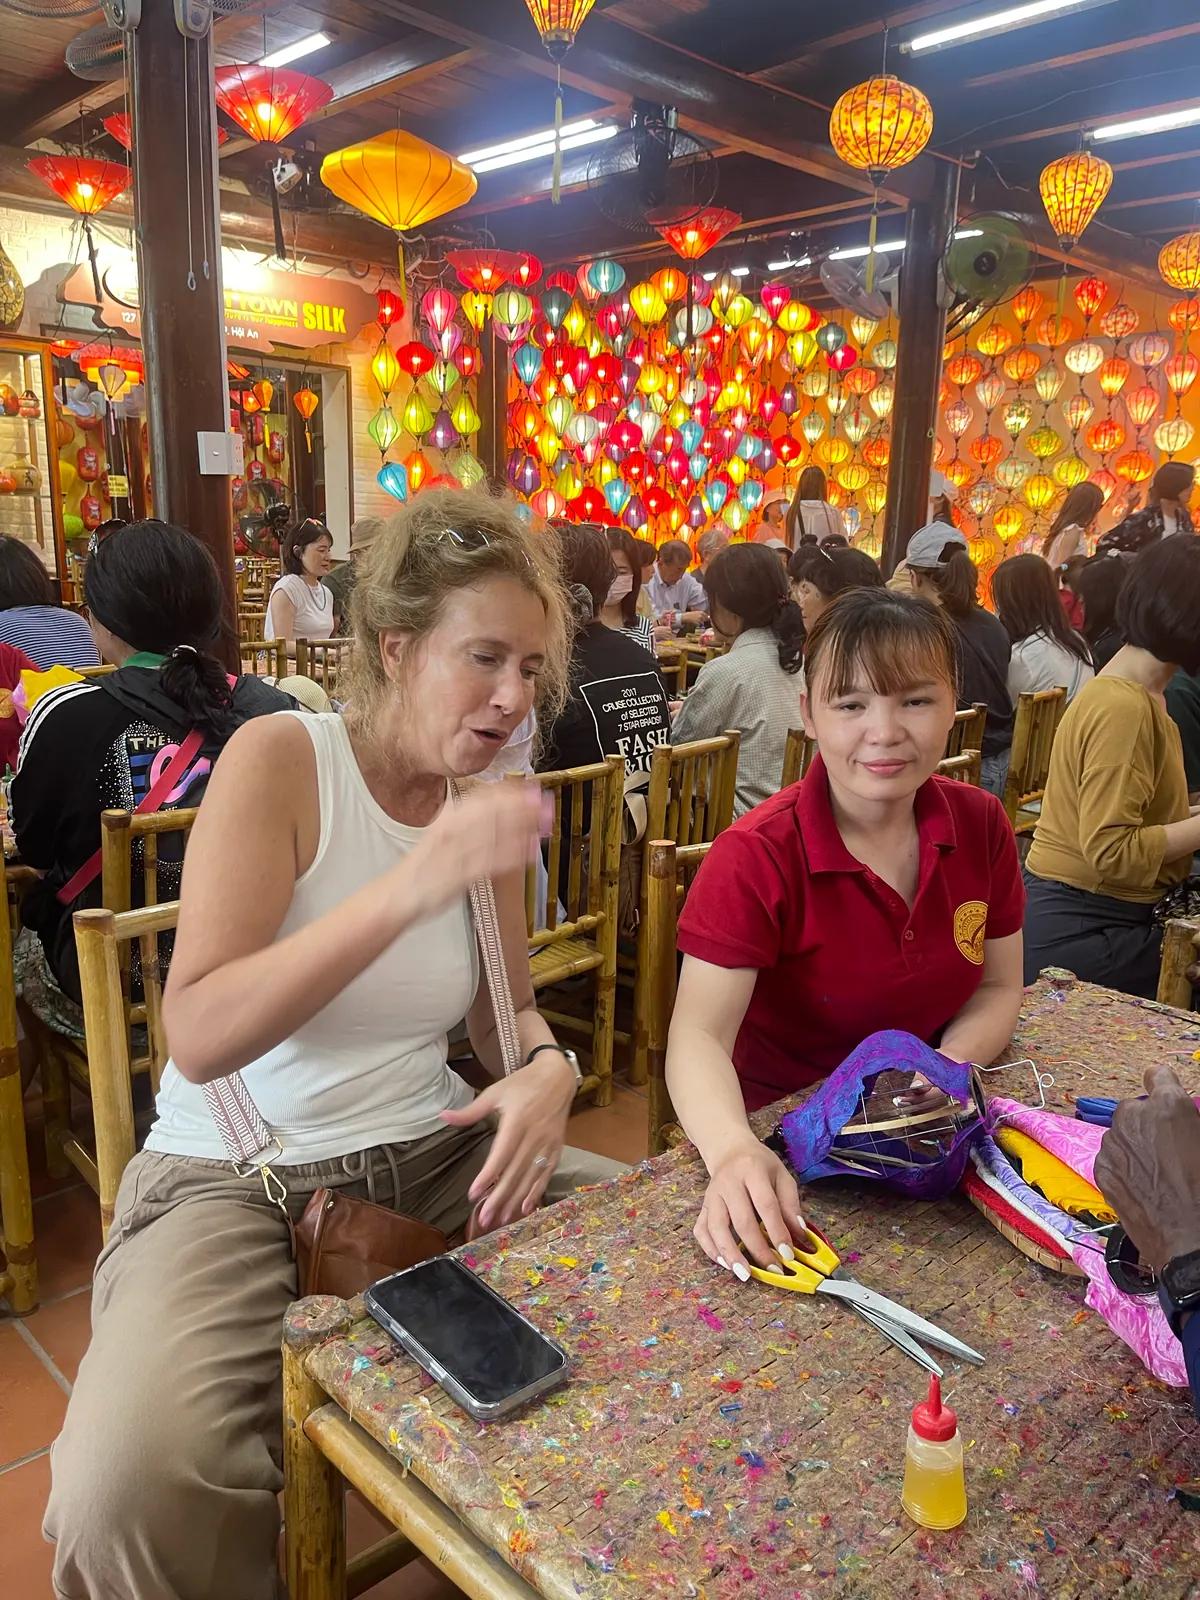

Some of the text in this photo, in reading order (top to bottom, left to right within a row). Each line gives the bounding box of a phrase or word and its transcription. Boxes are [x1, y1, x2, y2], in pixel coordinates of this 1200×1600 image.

[121, 311, 137, 323] 127
[236, 291, 298, 317] TOWN
[302, 301, 347, 334] SILK
[247, 328, 259, 340] An
[621, 688, 637, 698] 2017
[602, 694, 662, 713] CRUISE COLLECTION
[629, 706, 659, 719] SELECTED
[618, 724, 623, 732] 7
[624, 720, 640, 731] STAR
[129, 736, 166, 751] THE
[615, 728, 668, 758] FASH
